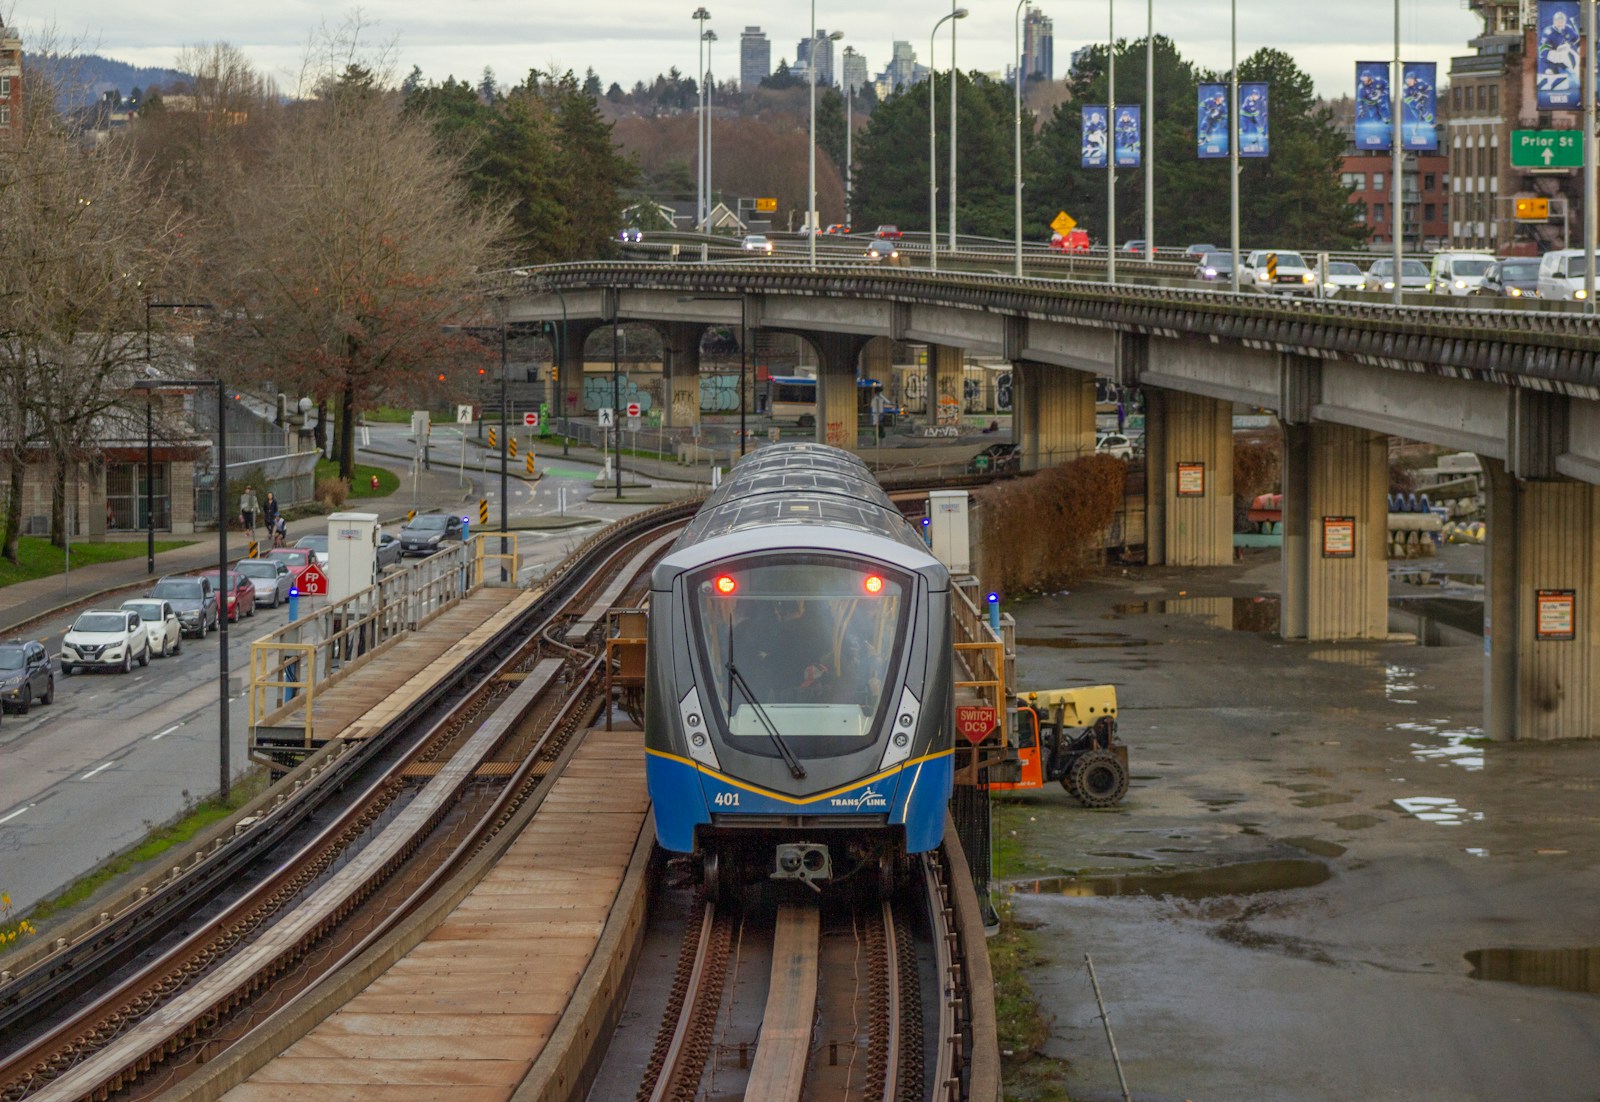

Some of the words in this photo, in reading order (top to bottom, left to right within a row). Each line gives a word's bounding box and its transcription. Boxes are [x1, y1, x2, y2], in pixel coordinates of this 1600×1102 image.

[1521, 136, 1554, 146] Prior
[1559, 136, 1574, 146] St
[305, 572, 319, 582] FP
[305, 583, 318, 593] 10
[960, 710, 992, 722] SWITCH
[964, 722, 987, 732] DC9
[714, 792, 740, 806] 401
